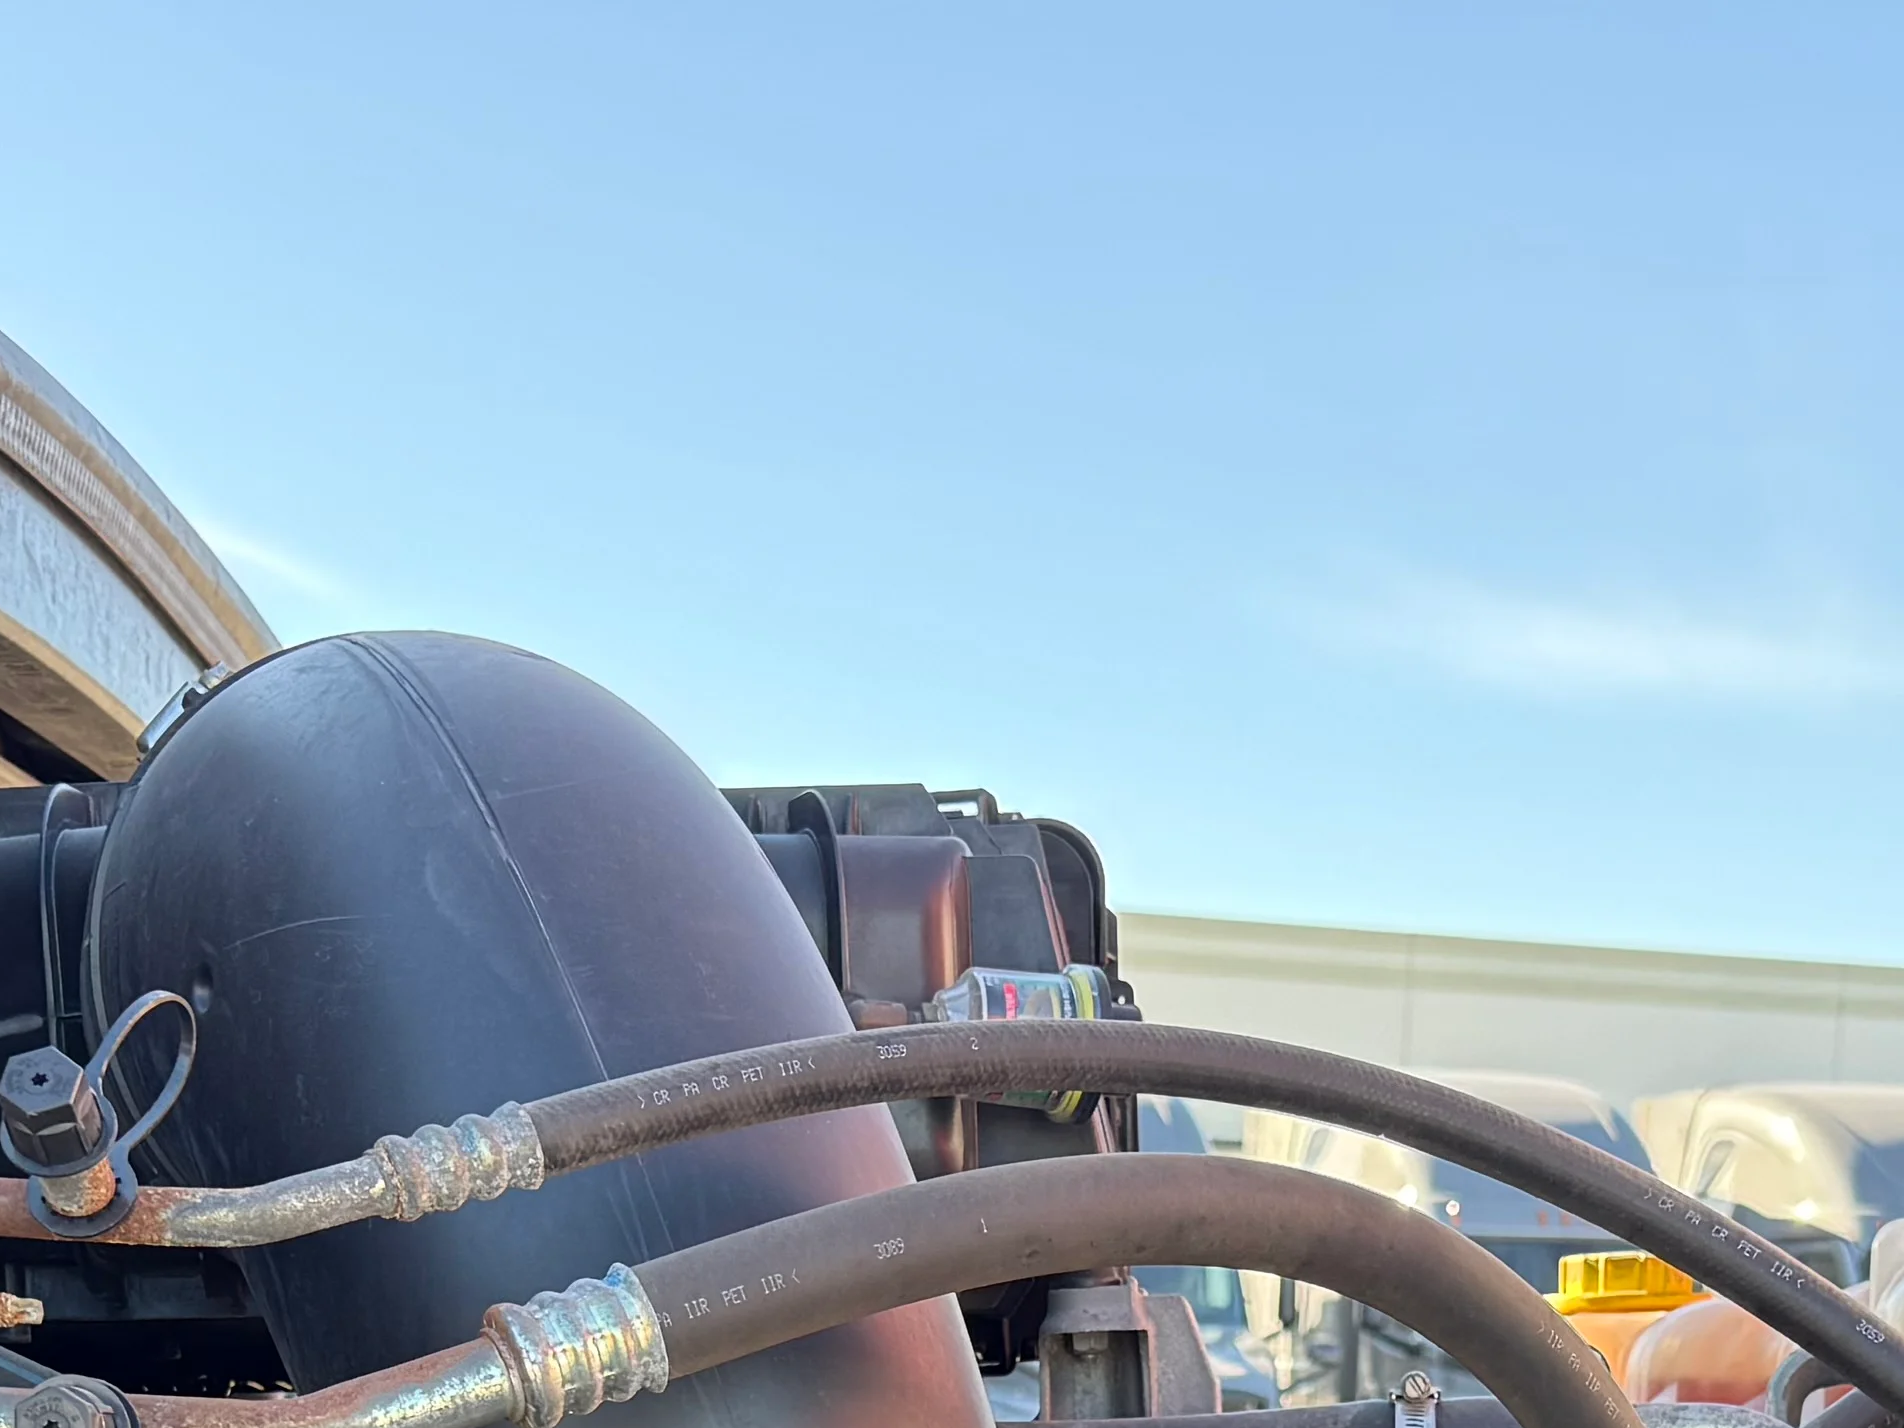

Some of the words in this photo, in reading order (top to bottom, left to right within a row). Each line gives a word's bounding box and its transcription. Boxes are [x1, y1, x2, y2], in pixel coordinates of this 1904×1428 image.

[971, 1037, 978, 1050] 2
[712, 1076, 729, 1090] CR
[742, 1067, 764, 1082] PET
[1711, 1226, 1728, 1242] CR
[1737, 1240, 1761, 1260] PET
[723, 1286, 748, 1307] PET
